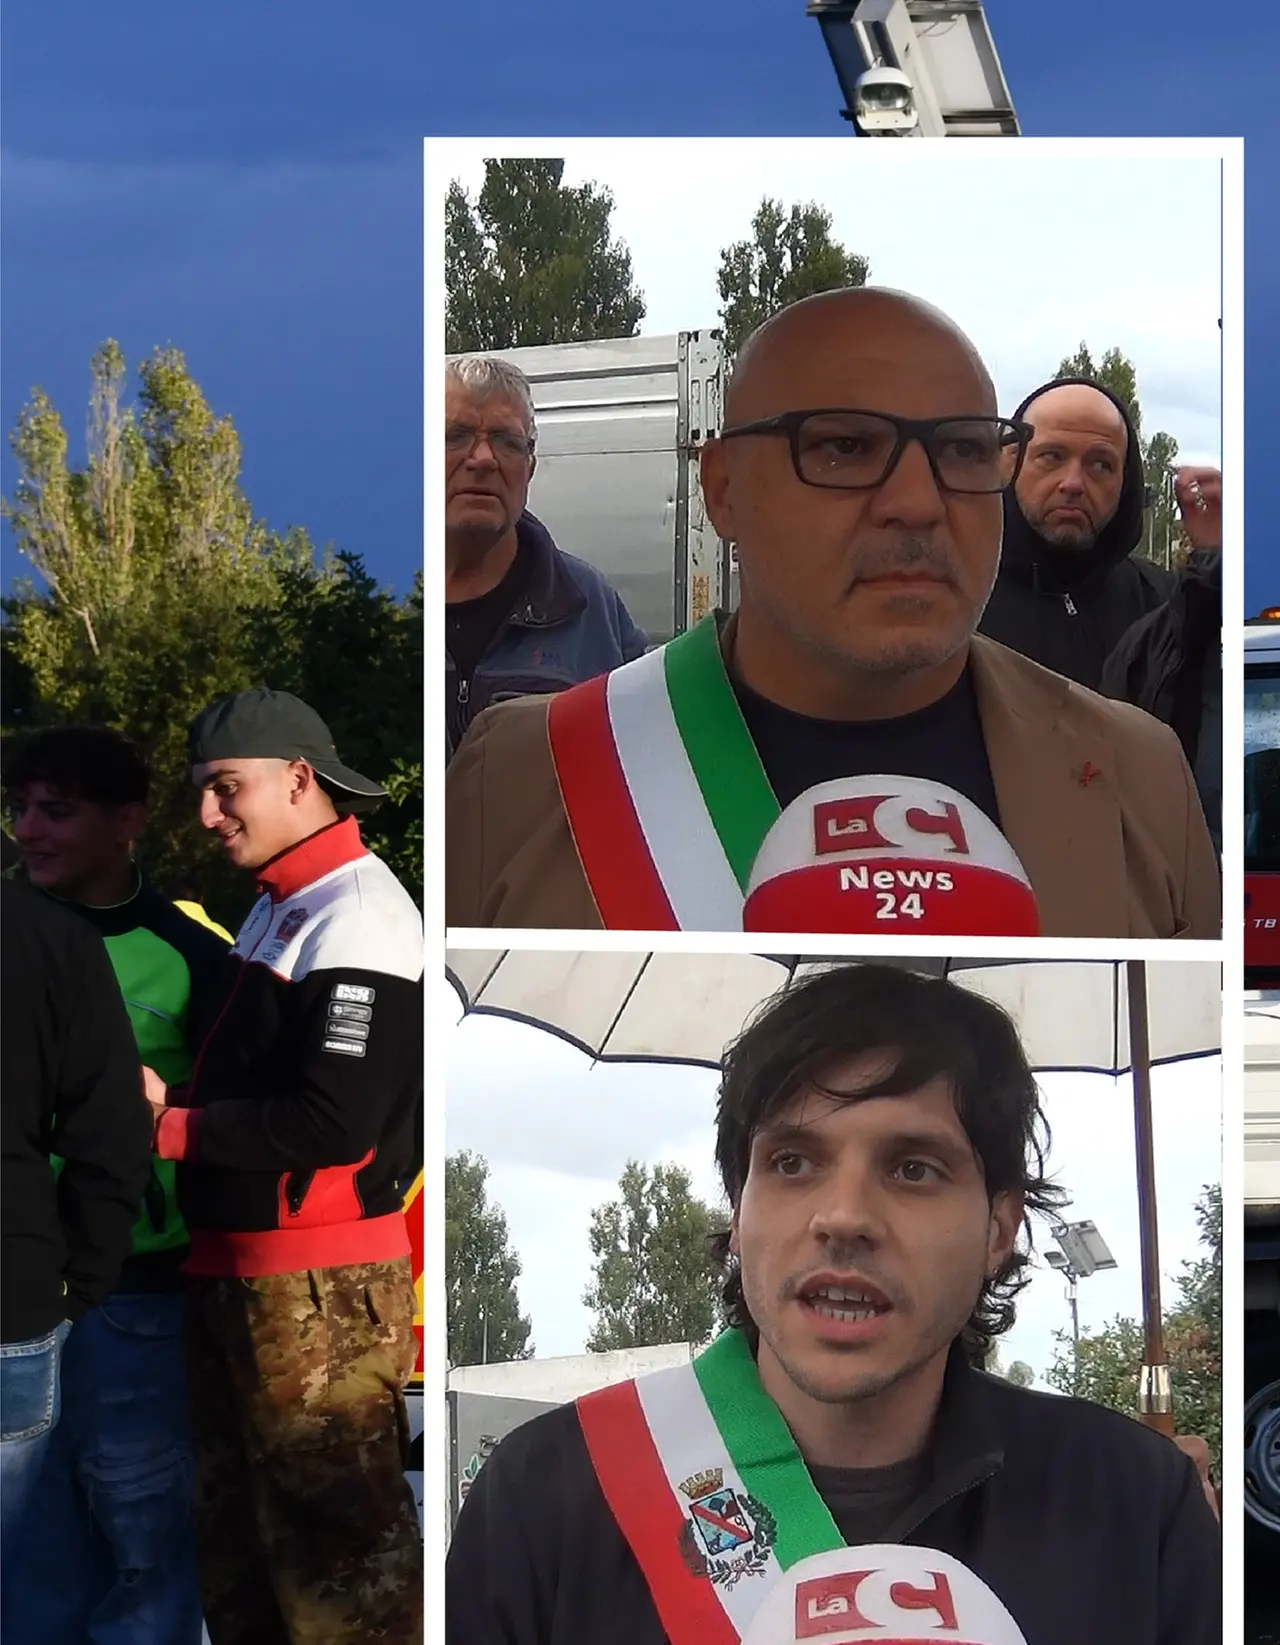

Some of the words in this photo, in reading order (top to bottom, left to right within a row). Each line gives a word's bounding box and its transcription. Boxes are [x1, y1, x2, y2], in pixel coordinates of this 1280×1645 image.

[827, 816, 868, 837] La
[840, 865, 953, 891] News
[876, 893, 924, 919] 24
[807, 1593, 849, 1619] La
